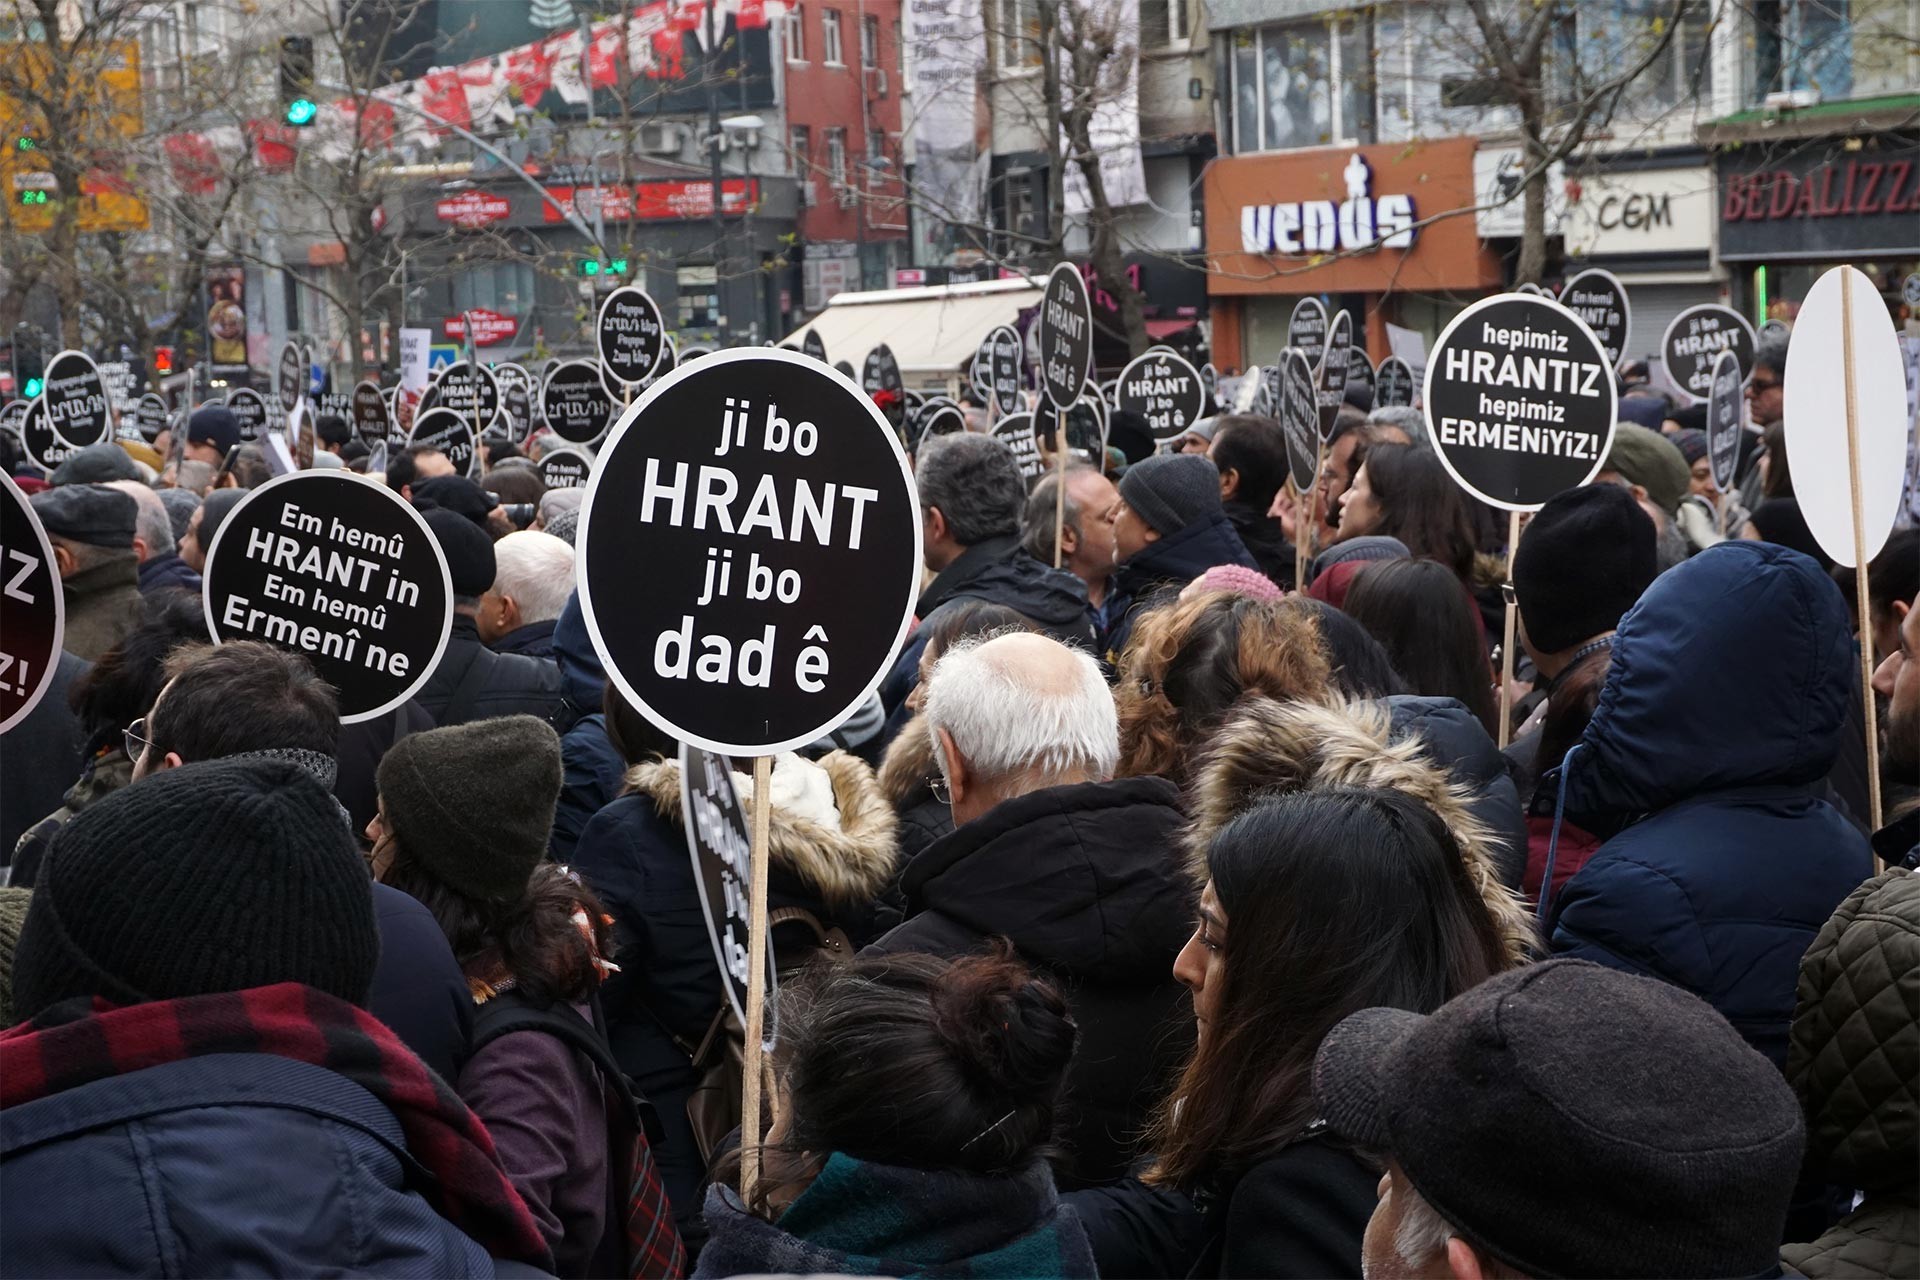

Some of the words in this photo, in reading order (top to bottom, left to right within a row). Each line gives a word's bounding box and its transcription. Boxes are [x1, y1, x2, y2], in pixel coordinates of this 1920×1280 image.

[1065, 284, 1076, 304] bo
[1047, 299, 1085, 342] HRANT
[1607, 308, 1620, 326] in
[1701, 317, 1719, 332] bo
[1062, 338, 1072, 358] bo
[1482, 321, 1569, 353] hepimiz
[1674, 327, 1740, 357] HRANT
[1048, 360, 1068, 388] dad
[1128, 376, 1190, 398] HRANT
[1144, 363, 1153, 381] ji
[1154, 363, 1172, 376] bo
[1446, 347, 1601, 398] HRANTIZ
[1688, 371, 1712, 390] da
[441, 385, 477, 397] HRAN
[1146, 395, 1156, 410] ji
[1157, 396, 1174, 409] bo
[1143, 411, 1170, 429] ad
[1173, 409, 1185, 428] ê
[1479, 392, 1566, 424] hepimiz
[714, 397, 750, 456] ji
[763, 403, 819, 457] bo
[546, 463, 558, 473] Em
[640, 457, 879, 550] HRANT
[279, 501, 321, 536] Em
[328, 516, 405, 560] hemû
[245, 526, 380, 593] HRANT
[386, 568, 420, 608] in
[697, 547, 733, 606] ji
[746, 552, 802, 604] bo
[263, 572, 306, 607] Em
[313, 588, 387, 631] hemû
[223, 593, 361, 661] Ermenî
[365, 644, 410, 678] ne
[653, 615, 777, 689] dad
[795, 624, 830, 693] ê
